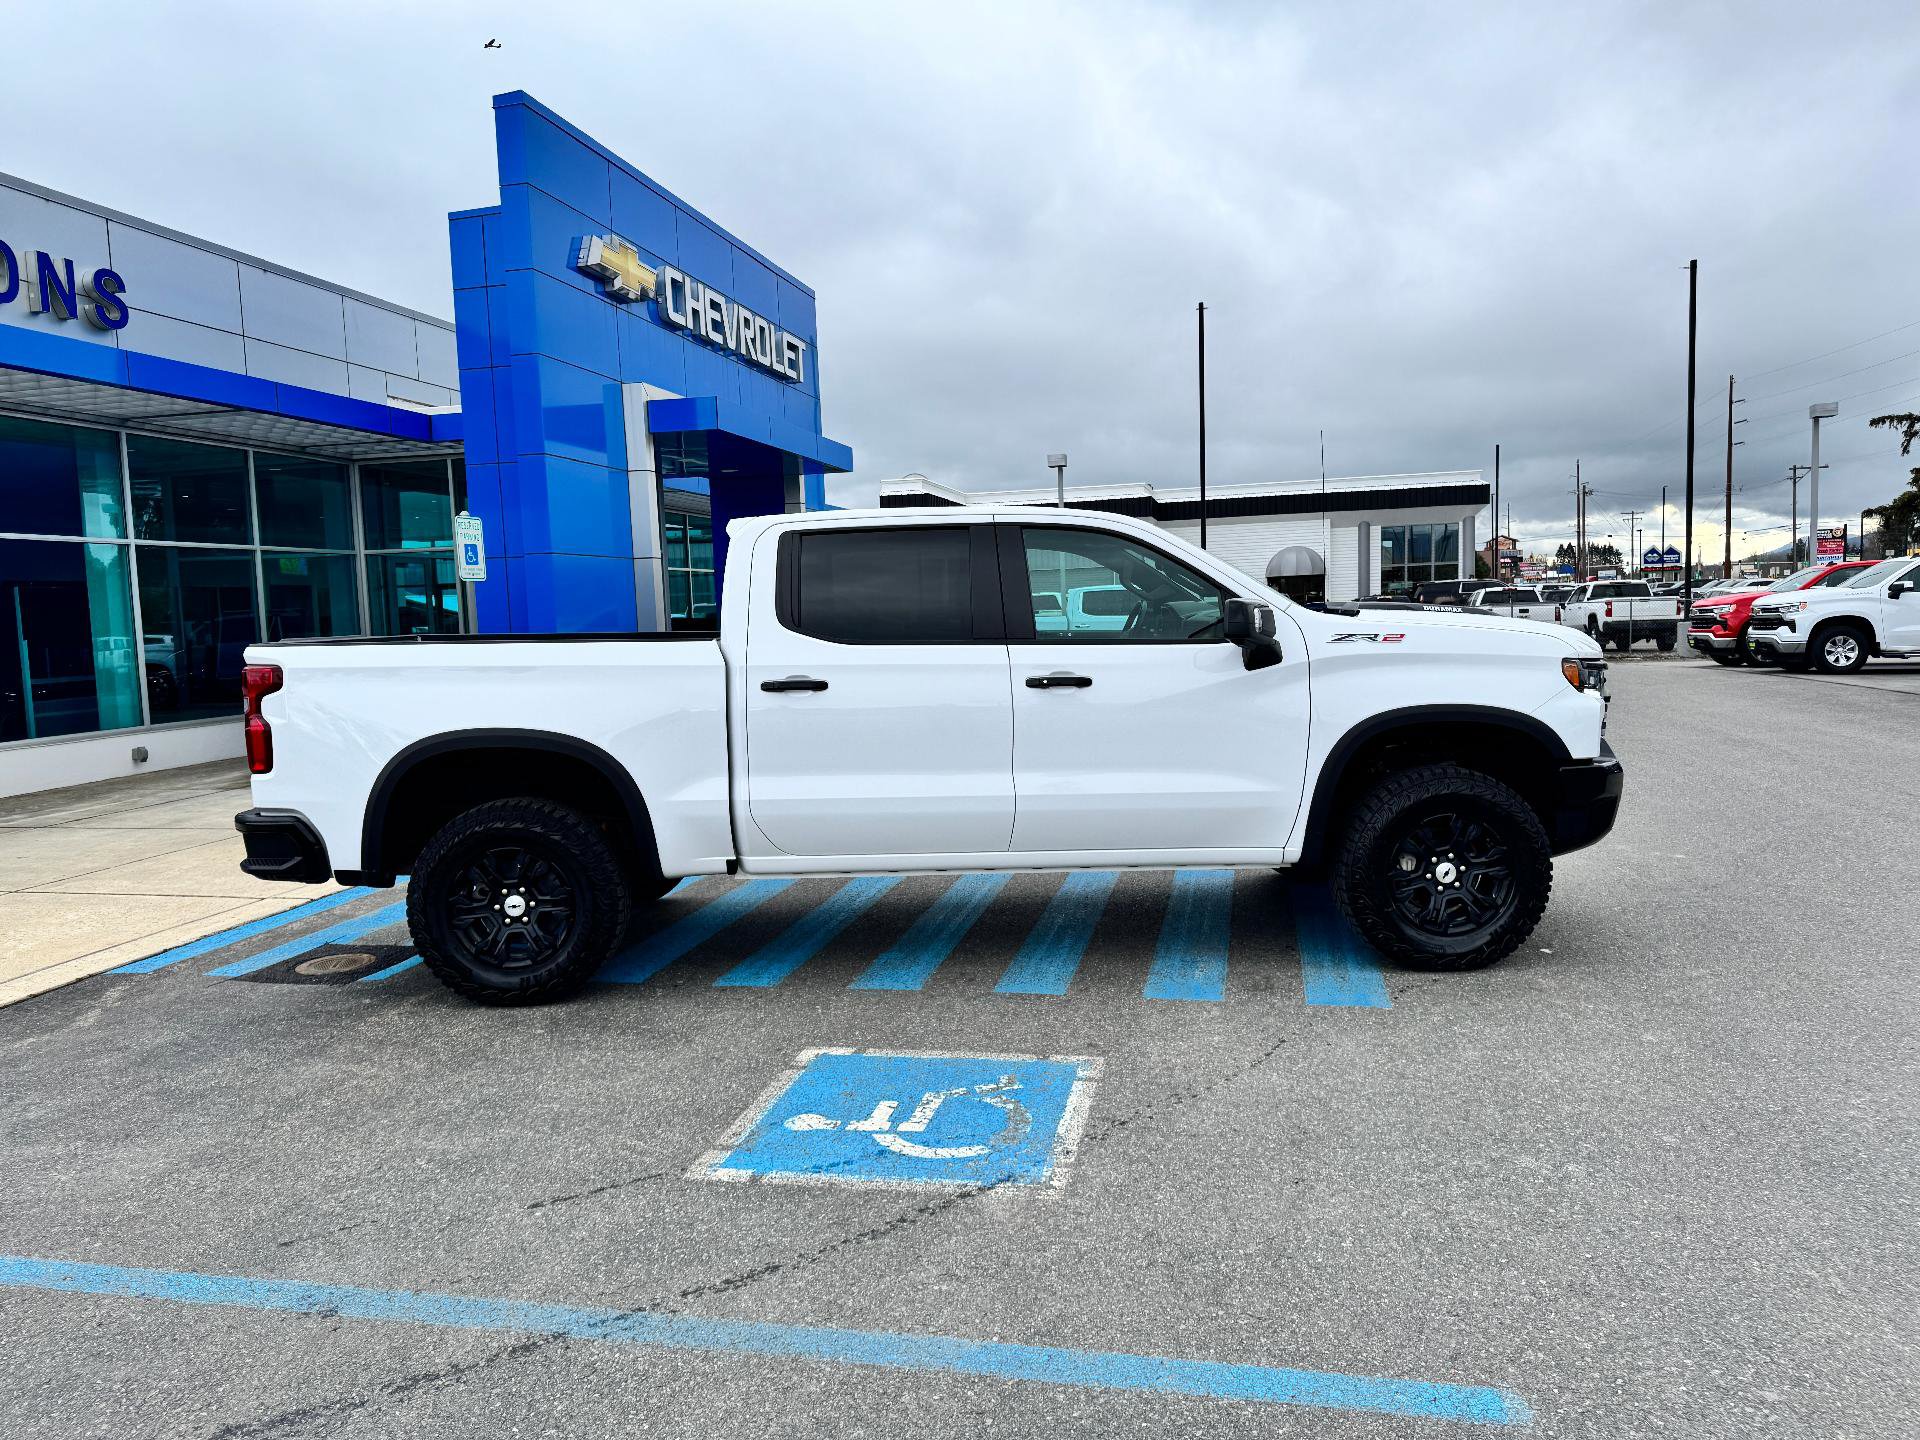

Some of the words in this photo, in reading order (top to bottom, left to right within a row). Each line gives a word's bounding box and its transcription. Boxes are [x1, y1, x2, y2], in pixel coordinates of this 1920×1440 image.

[656, 265, 806, 383] CHEVROLET
[1422, 605, 1463, 613] DURAMAX
[1326, 633, 1406, 643] ZR2
